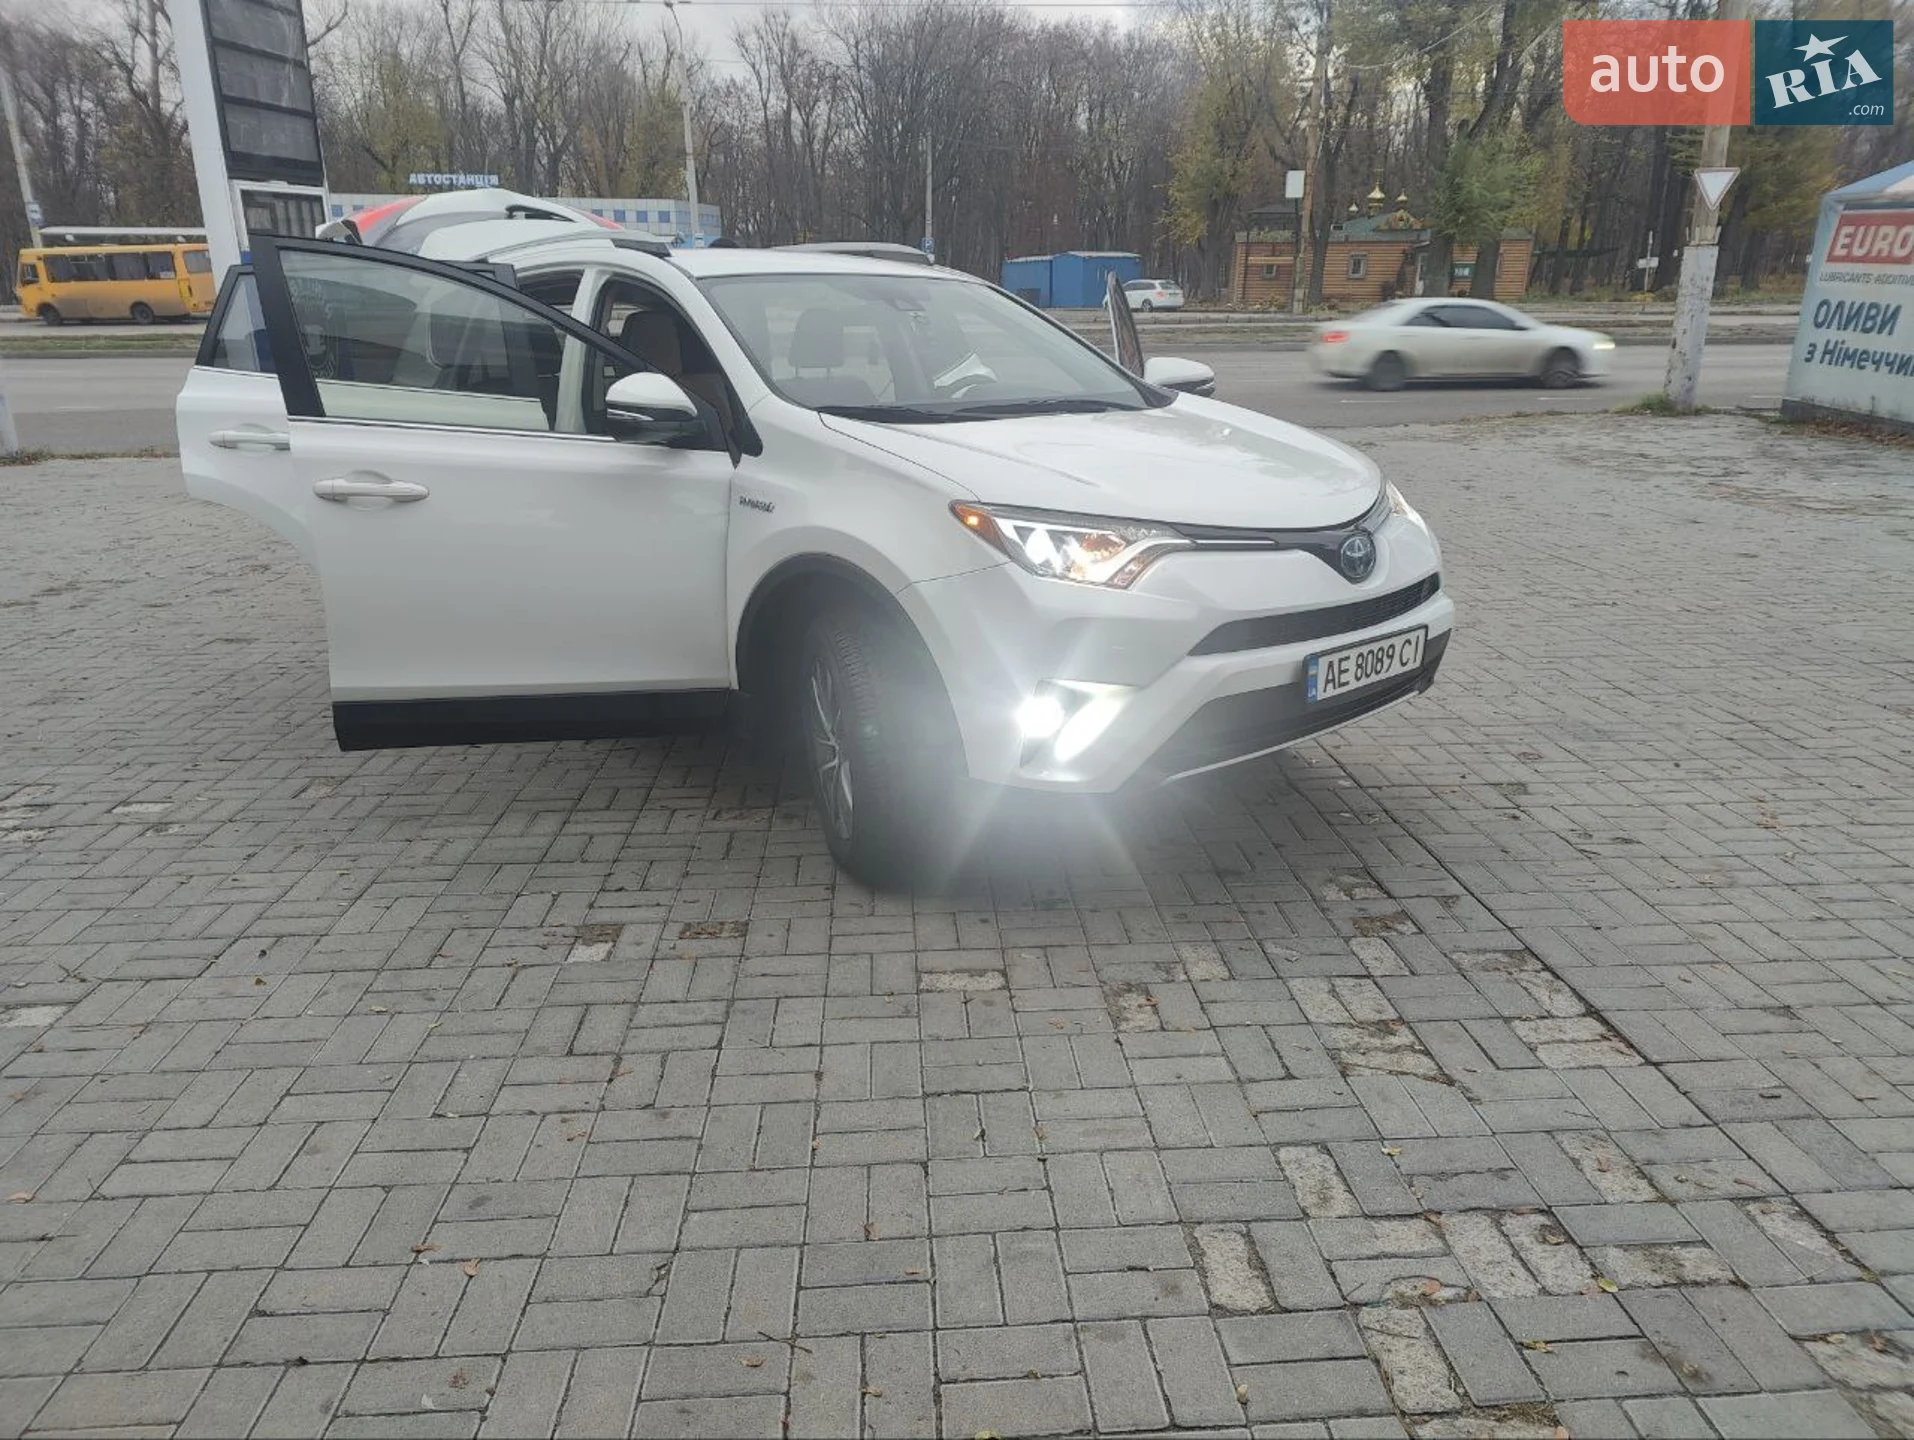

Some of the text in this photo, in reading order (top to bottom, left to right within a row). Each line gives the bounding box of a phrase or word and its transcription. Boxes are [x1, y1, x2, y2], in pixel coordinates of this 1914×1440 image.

[409, 173, 499, 188] АВТОСТАНЦІЯ
[1813, 299, 1902, 336] ОЛИВИ
[1804, 342, 1817, 363] з
[1323, 635, 1420, 693] AE 8089 CI
